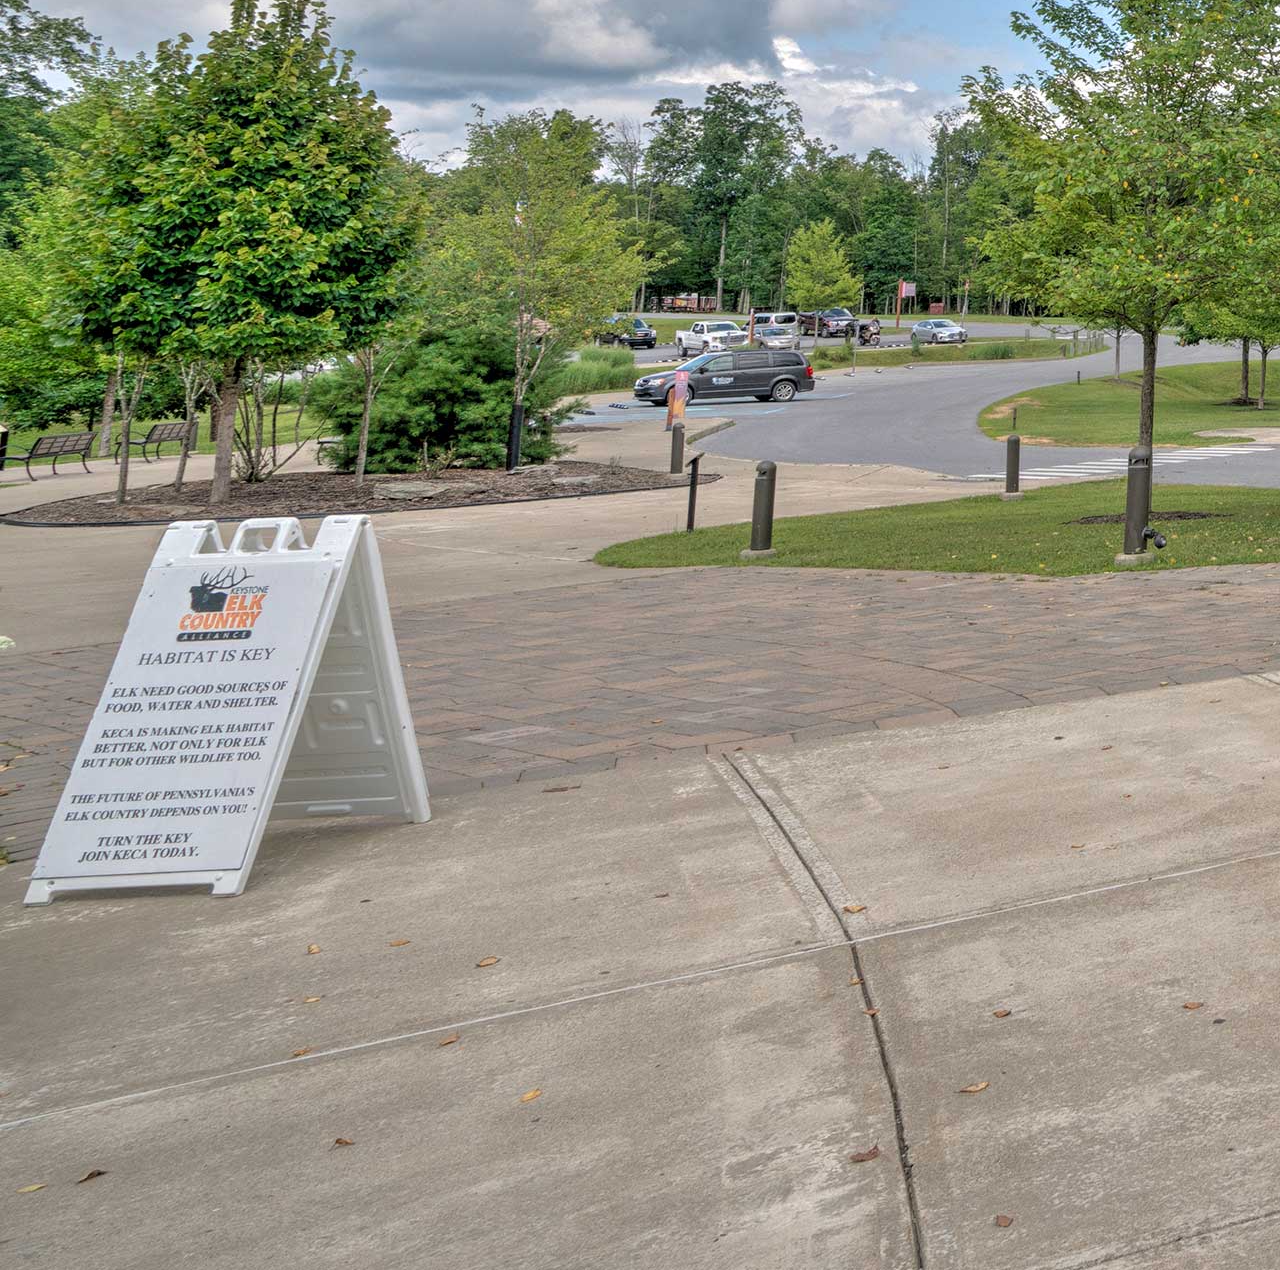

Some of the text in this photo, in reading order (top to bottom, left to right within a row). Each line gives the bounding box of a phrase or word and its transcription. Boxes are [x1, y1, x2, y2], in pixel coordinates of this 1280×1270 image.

[230, 586, 269, 594] KEYSTONE
[225, 595, 265, 611] ELK
[179, 612, 260, 630] COUNTRY
[182, 631, 246, 640] ALLIANCE
[138, 648, 275, 666] HABITAT IS KEY
[112, 681, 288, 698] ELK NEED GOOD SOURCES OF
[105, 697, 278, 713] FOOD, WATER AND SHELTER.
[101, 722, 274, 738] KECA IS MAKING ELK HABITAT
[149, 740, 177, 751] NOT
[180, 738, 212, 750] ONLY
[216, 737, 240, 747] FOR
[243, 736, 267, 746] ELK
[81, 751, 261, 768] BUT FOR OTHER WILDLIFE TOO.
[70, 787, 255, 804] THE FUTURE OF PENNSYLVANIA'S
[64, 804, 248, 821] ELK COUNTRY DEPENDS ON YOU!
[97, 833, 192, 847] TURN THE KEY
[78, 846, 199, 863] JOIN KECA TODAY.
